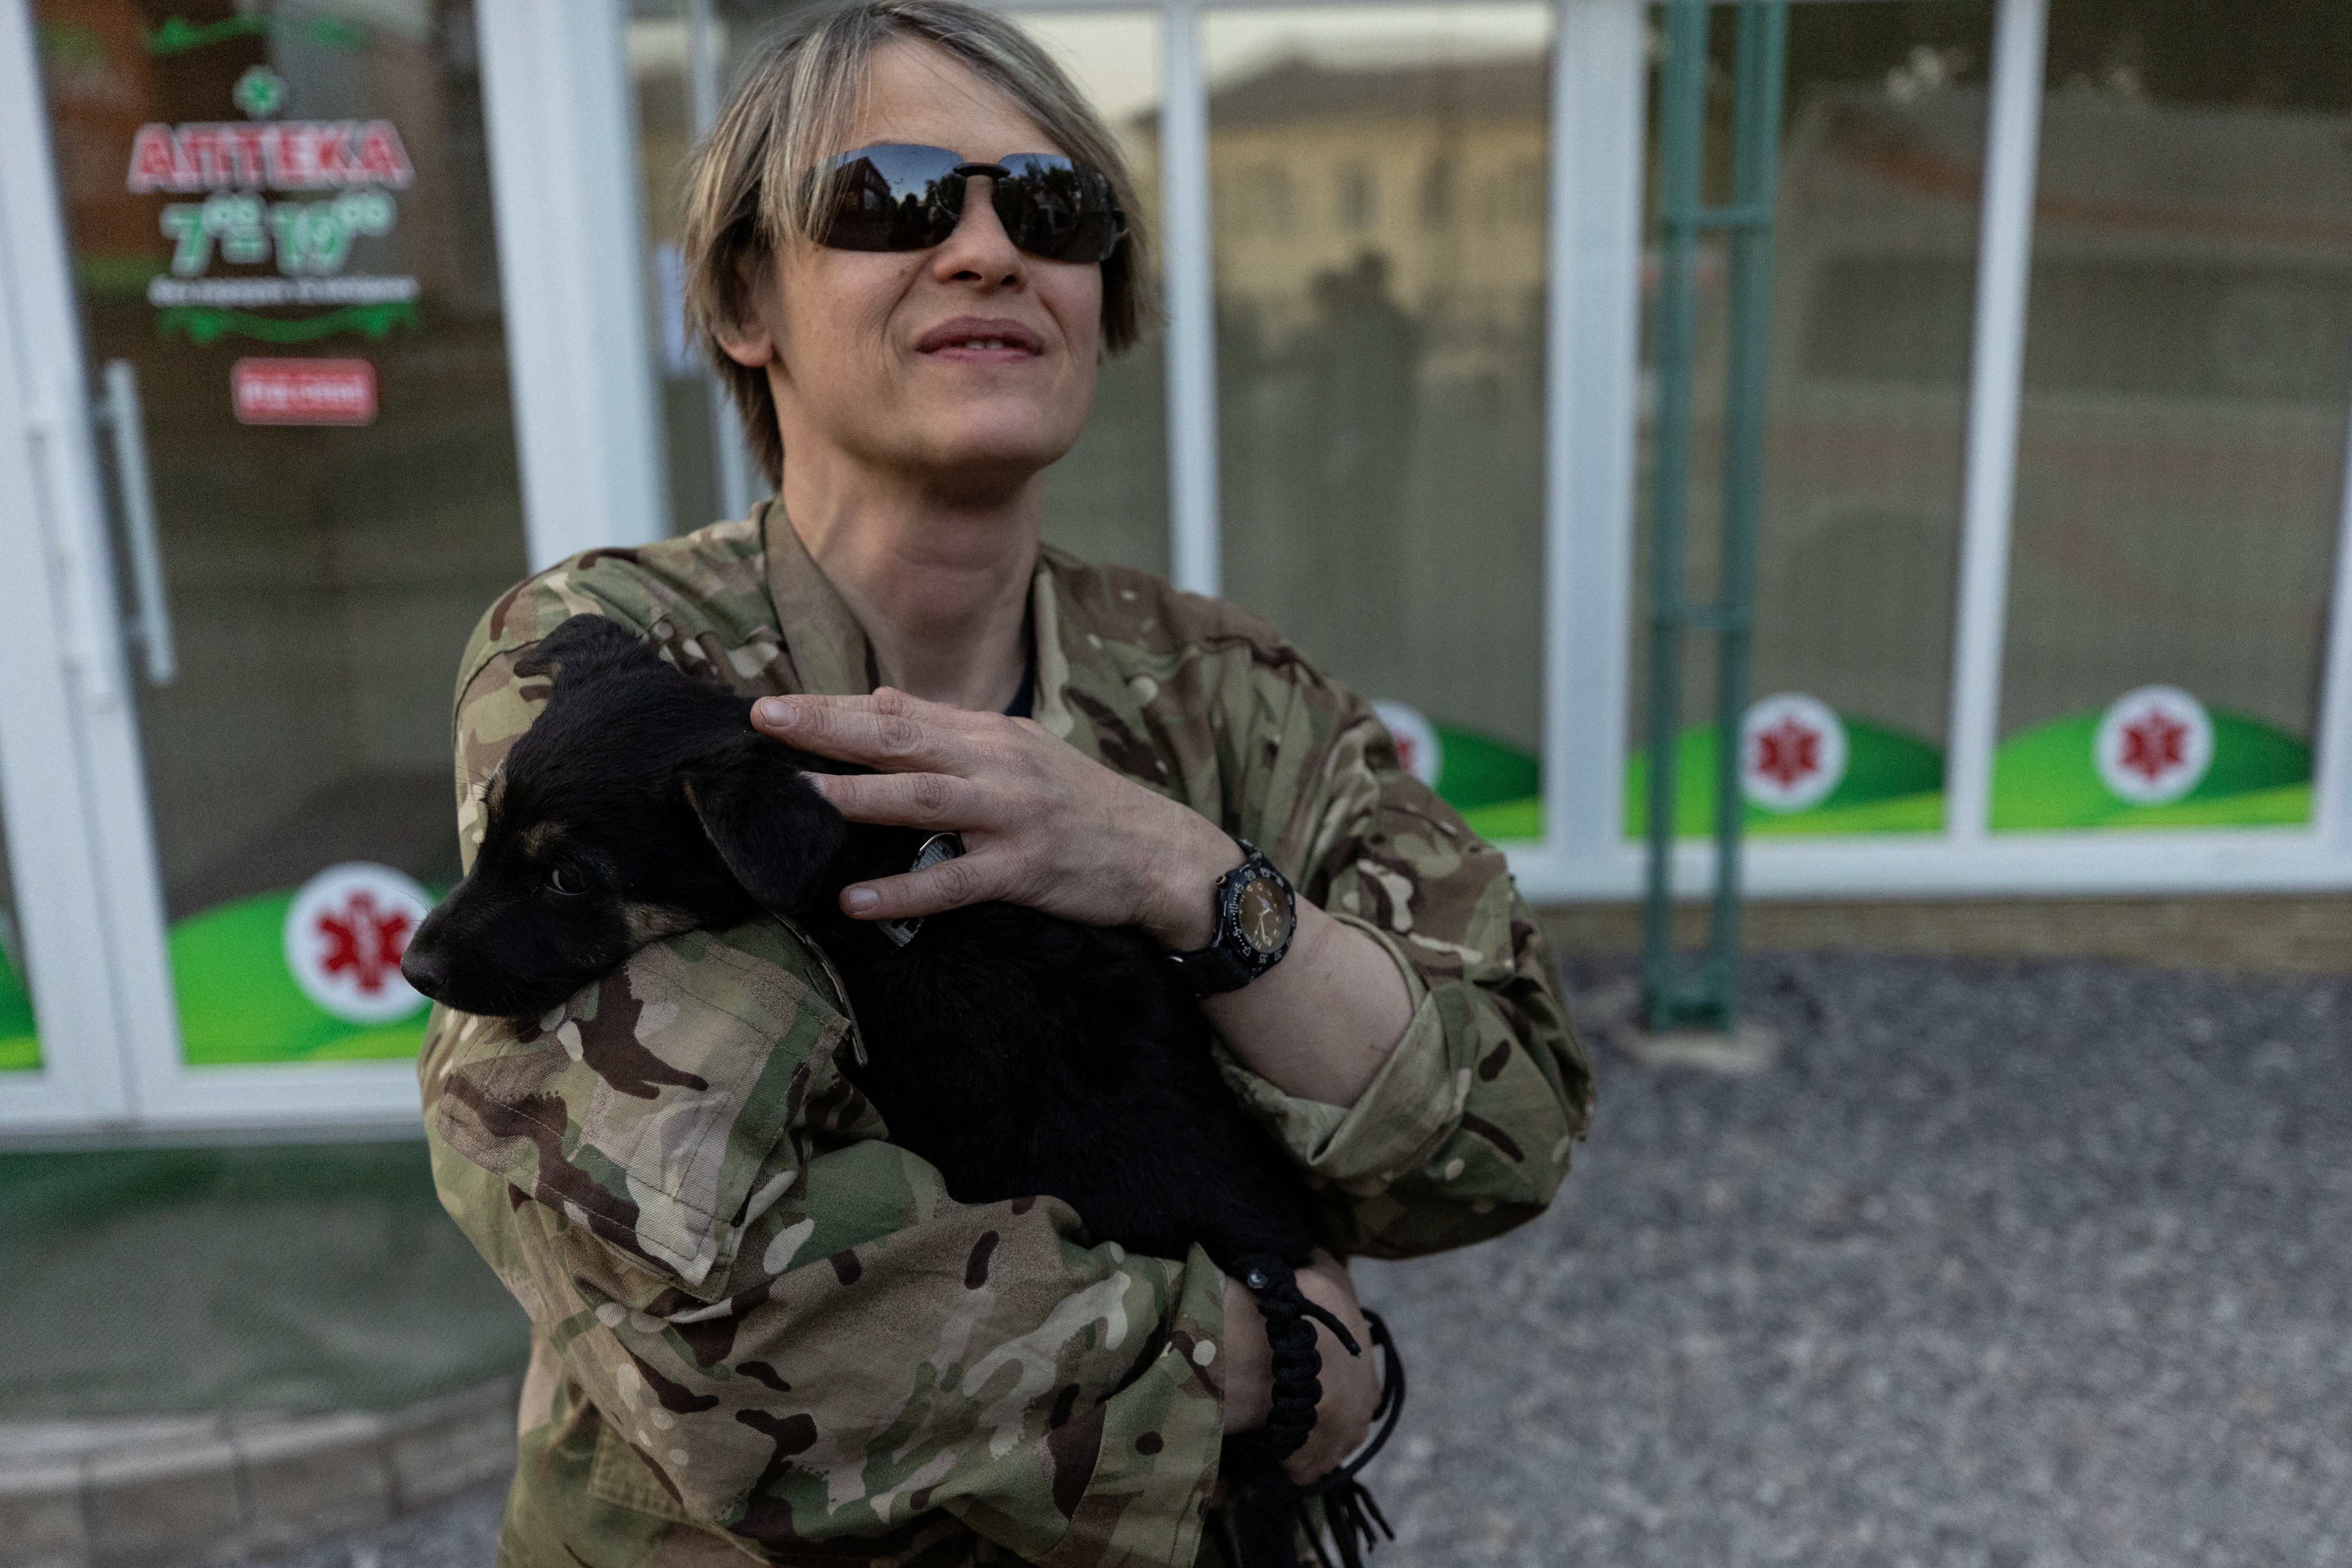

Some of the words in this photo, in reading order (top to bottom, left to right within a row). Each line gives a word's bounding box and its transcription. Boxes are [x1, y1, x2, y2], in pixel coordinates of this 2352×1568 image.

[128, 122, 414, 192] АПТЕКА
[1235, 882, 1244, 893] 15
[1230, 904, 1238, 913] 10
[1233, 928, 1242, 936] 5
[1258, 953, 1268, 964] 55
